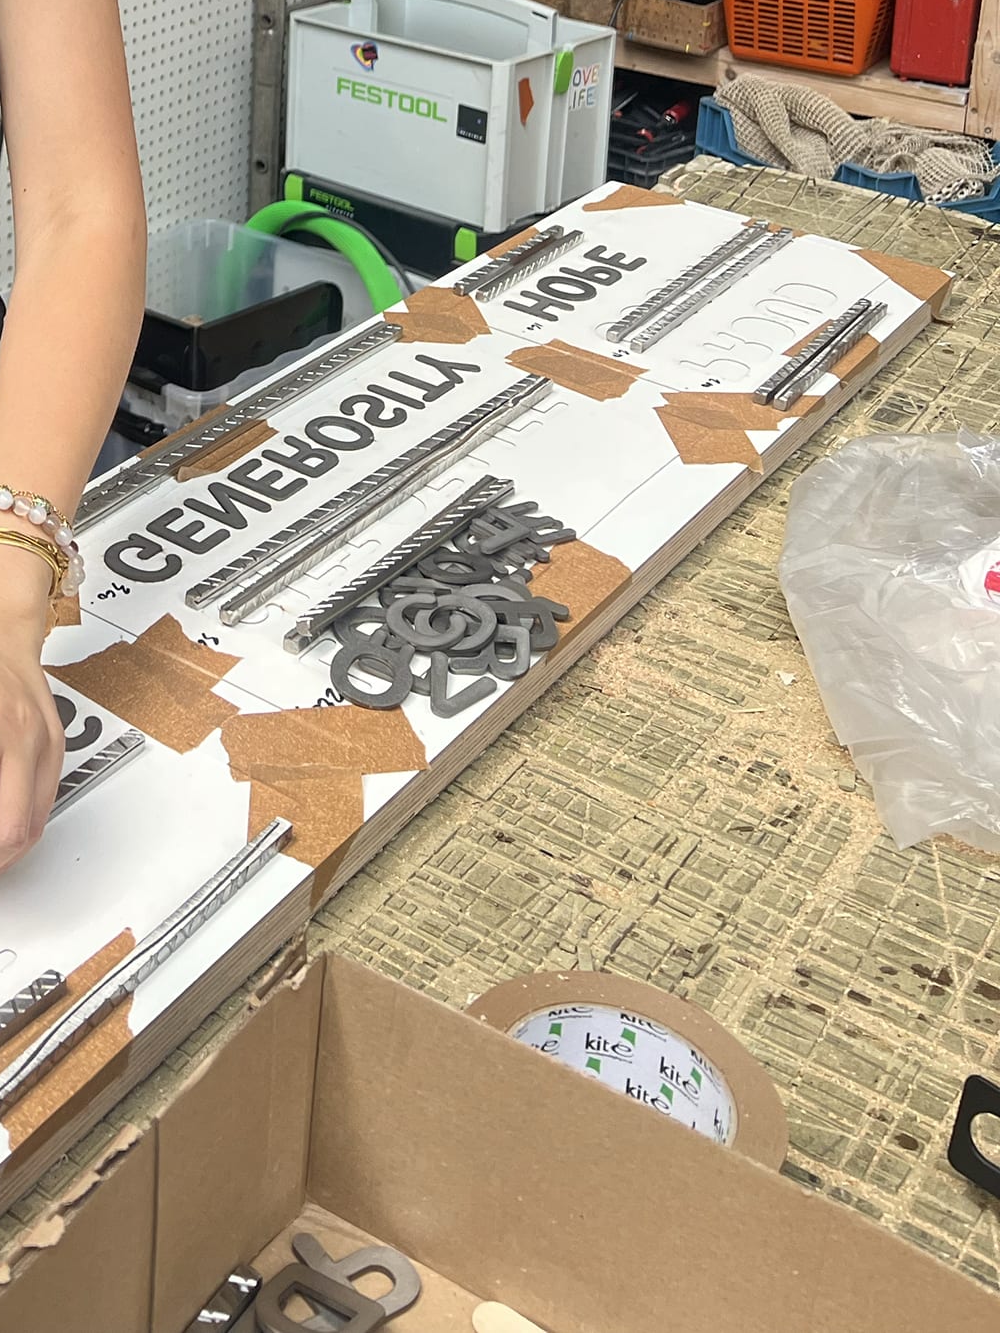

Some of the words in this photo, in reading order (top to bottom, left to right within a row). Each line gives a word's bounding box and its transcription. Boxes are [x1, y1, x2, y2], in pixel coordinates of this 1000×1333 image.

[336, 77, 448, 123] FESTOOL
[309, 188, 354, 212] FESTOOL
[585, 1032, 634, 1058] kite
[625, 1078, 672, 1116] kite
[659, 1056, 700, 1100] kite
